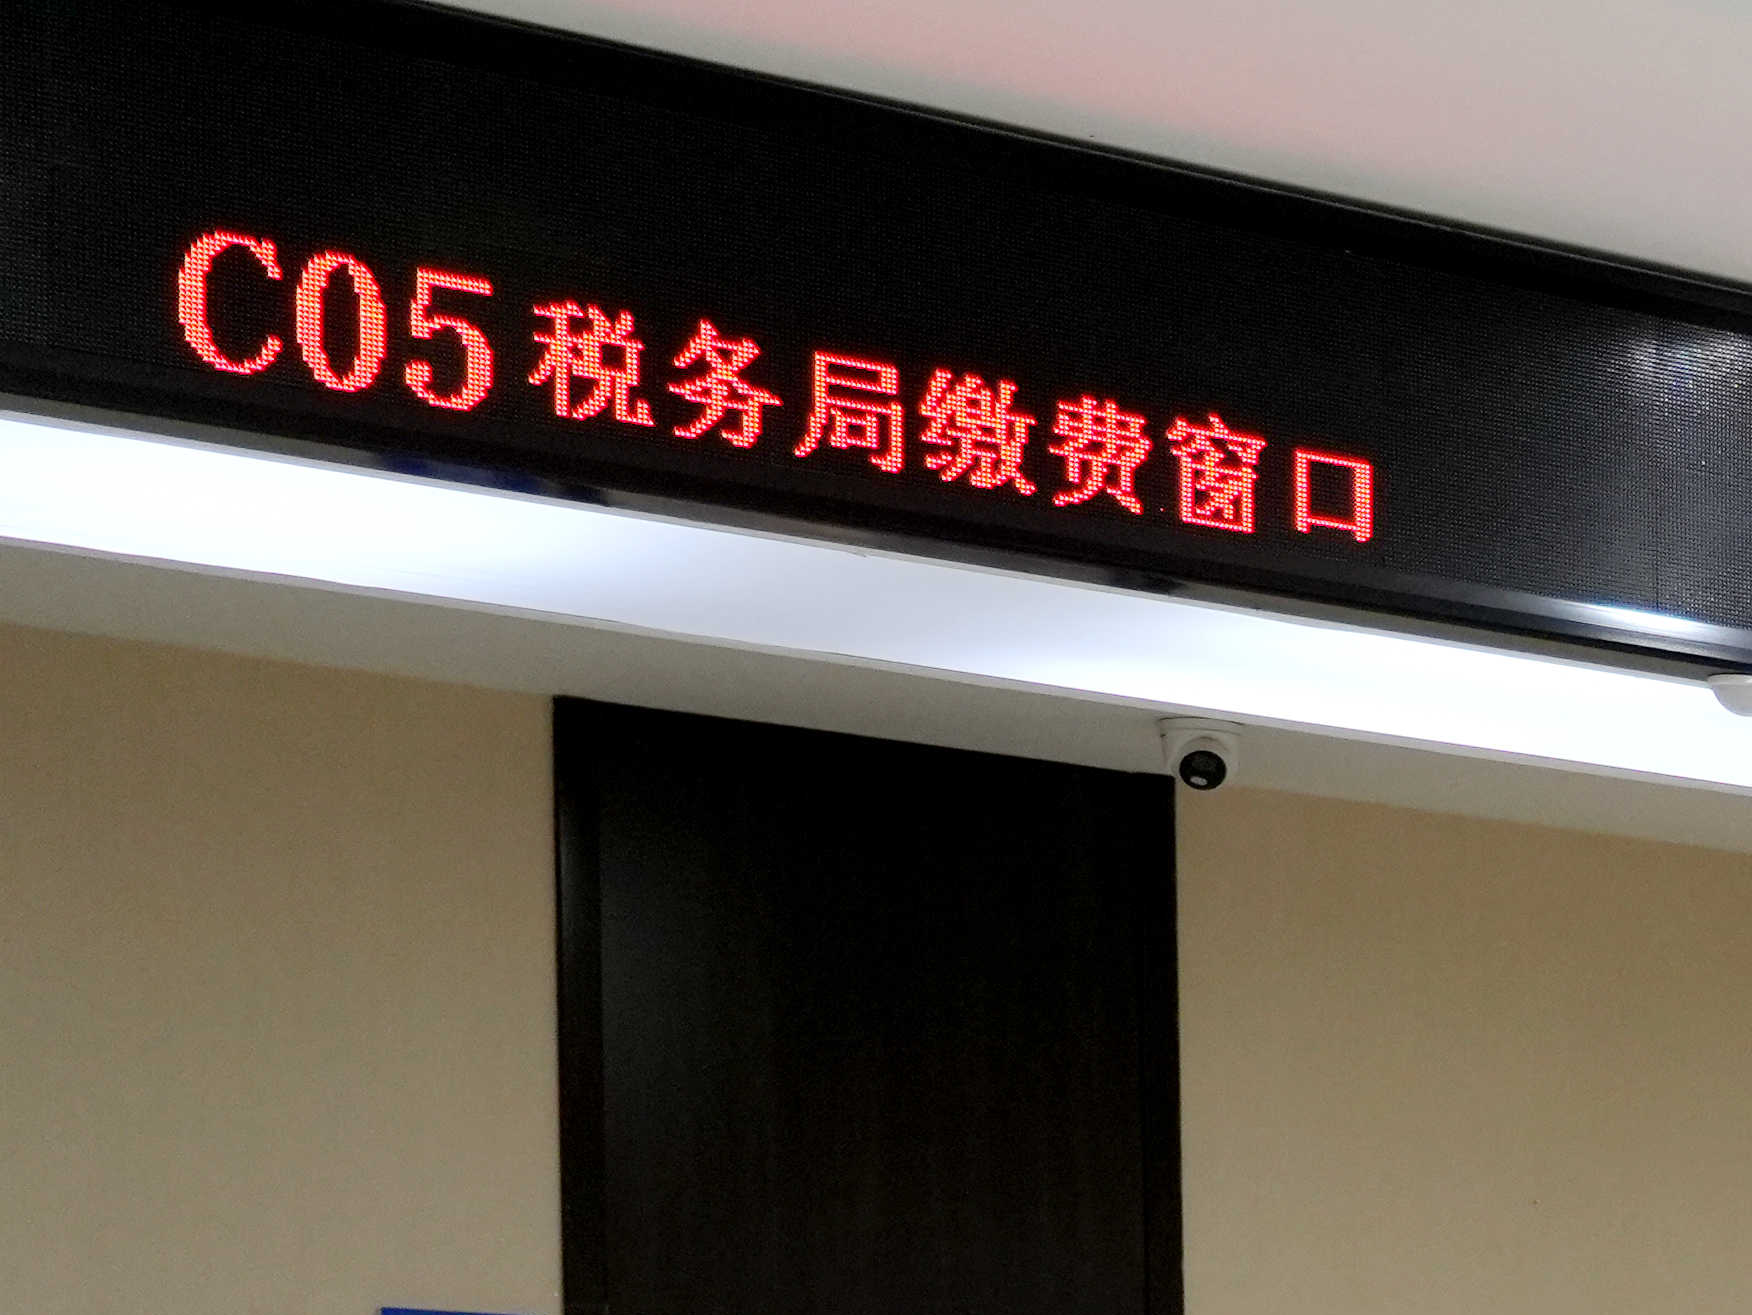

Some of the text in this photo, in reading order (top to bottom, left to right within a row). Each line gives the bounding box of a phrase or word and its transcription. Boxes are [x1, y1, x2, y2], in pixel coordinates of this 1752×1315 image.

[178, 230, 1374, 542] C05税务局缴费窗口
